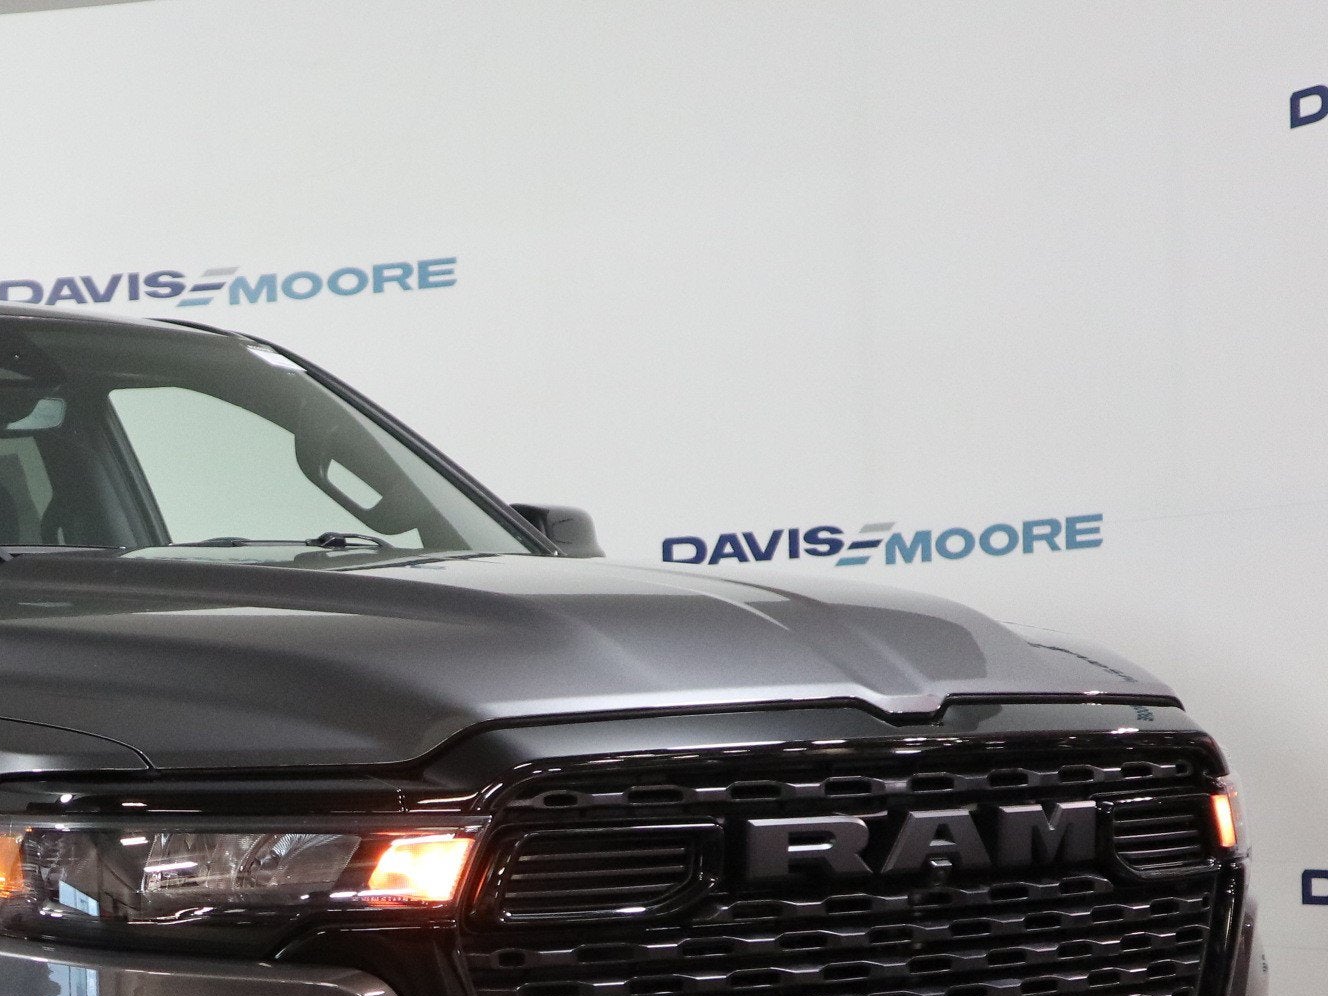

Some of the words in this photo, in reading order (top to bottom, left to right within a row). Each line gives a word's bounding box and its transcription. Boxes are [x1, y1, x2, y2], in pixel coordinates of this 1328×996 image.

[228, 256, 459, 306] MOORE
[661, 524, 847, 566] DAVIS
[884, 513, 1103, 567] MOORE
[747, 801, 1097, 878] RAM
